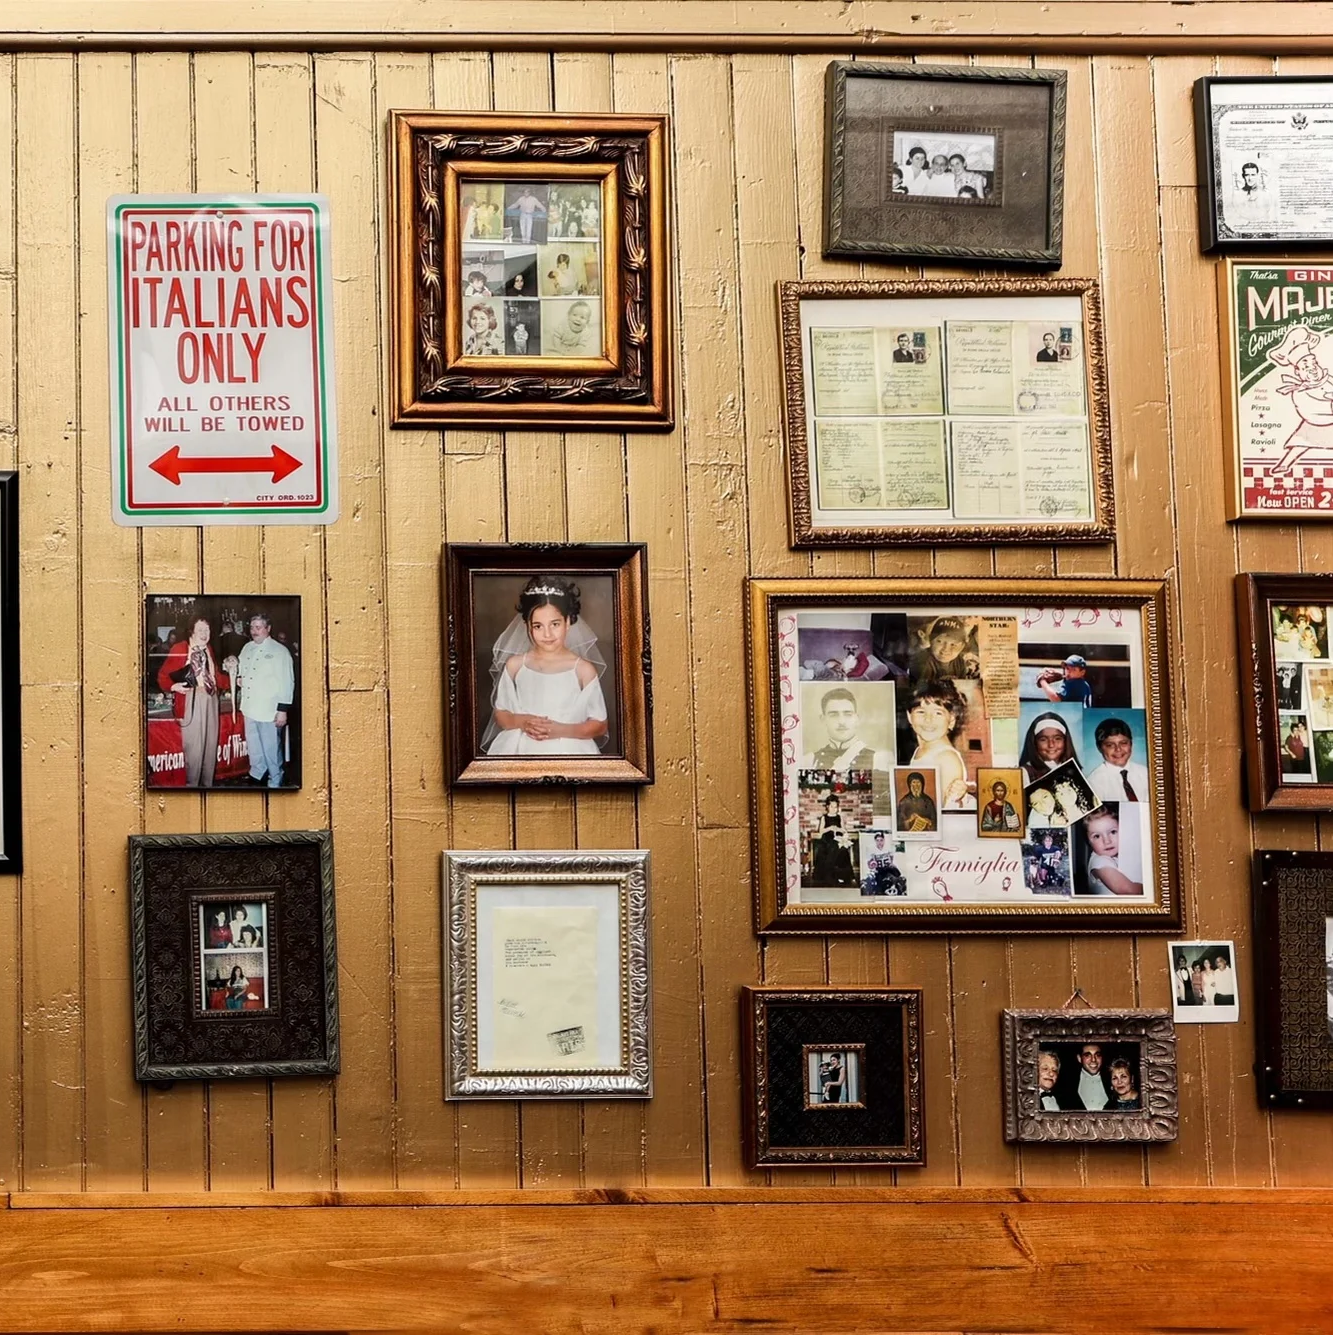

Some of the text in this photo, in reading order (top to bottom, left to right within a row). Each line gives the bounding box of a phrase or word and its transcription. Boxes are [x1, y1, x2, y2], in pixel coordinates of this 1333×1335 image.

[131, 219, 306, 273] PARKING FOR
[1294, 271, 1331, 281] GIN
[132, 276, 310, 329] ITALIANS
[1248, 312, 1333, 357] Gourmet Diner
[177, 331, 267, 385] ONLY
[157, 396, 290, 412] ALL OTHERS
[144, 416, 304, 432] WILL BE TOWED
[1251, 421, 1282, 429] Lasagna
[1257, 491, 1333, 508] Now OPEN 2
[223, 734, 231, 765] of
[232, 734, 249, 758] Win
[915, 845, 1020, 885] Famiglia
